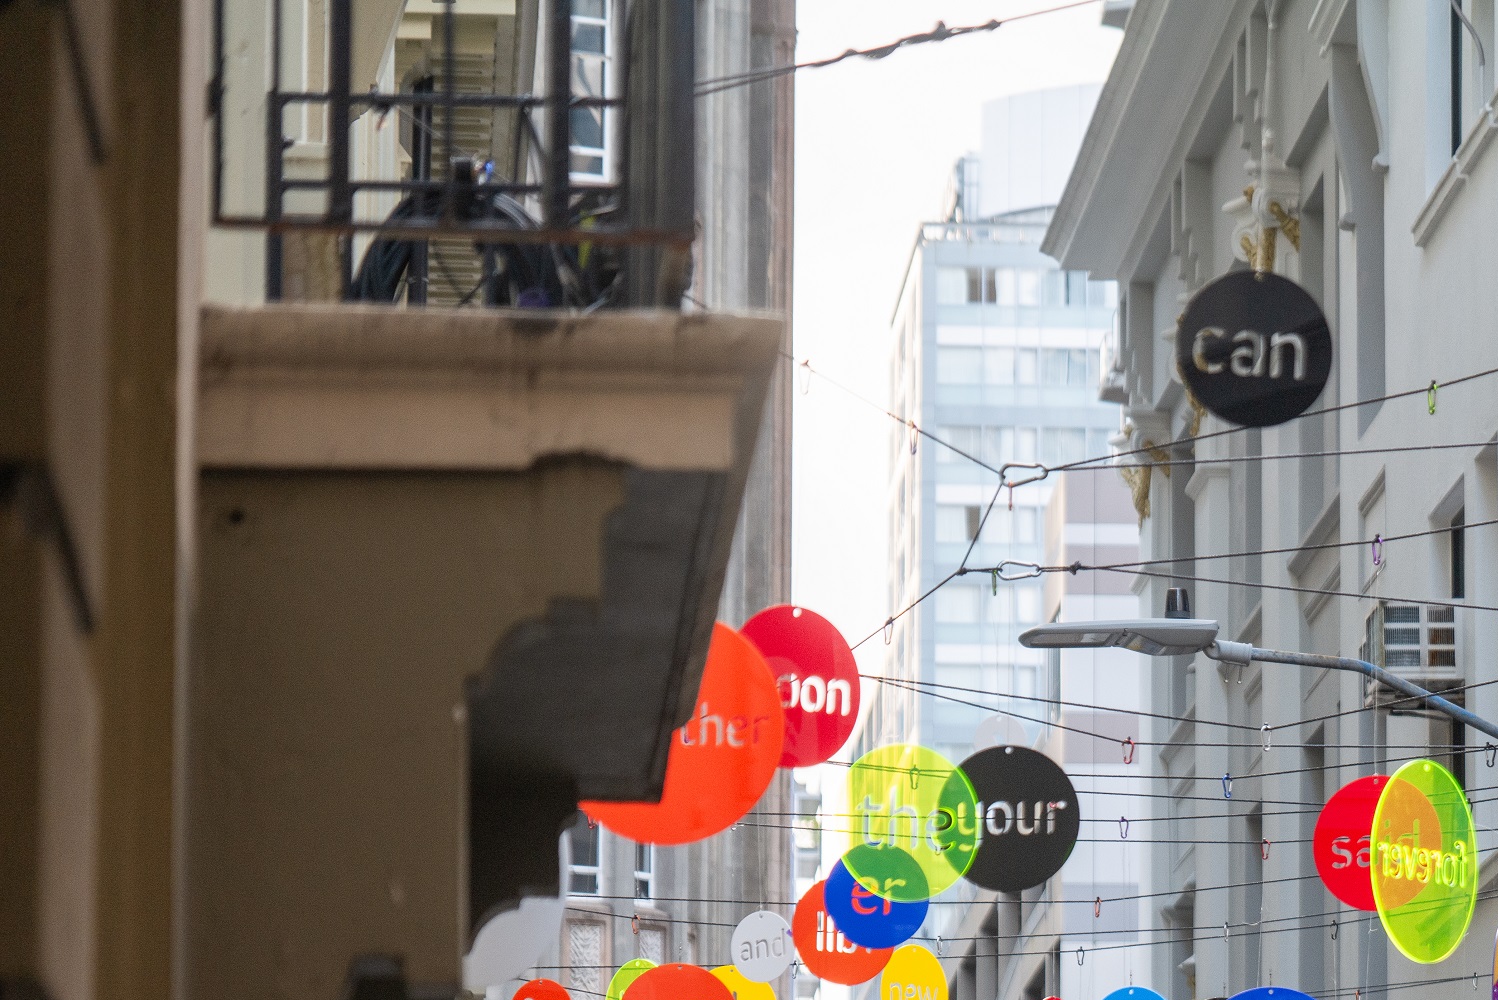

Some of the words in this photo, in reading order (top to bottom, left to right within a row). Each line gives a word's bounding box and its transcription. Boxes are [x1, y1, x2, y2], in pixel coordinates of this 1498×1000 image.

[1192, 326, 1307, 381] can
[856, 785, 956, 851] the
[957, 800, 1067, 852] your
[851, 874, 906, 916] er
[740, 928, 786, 963] and
